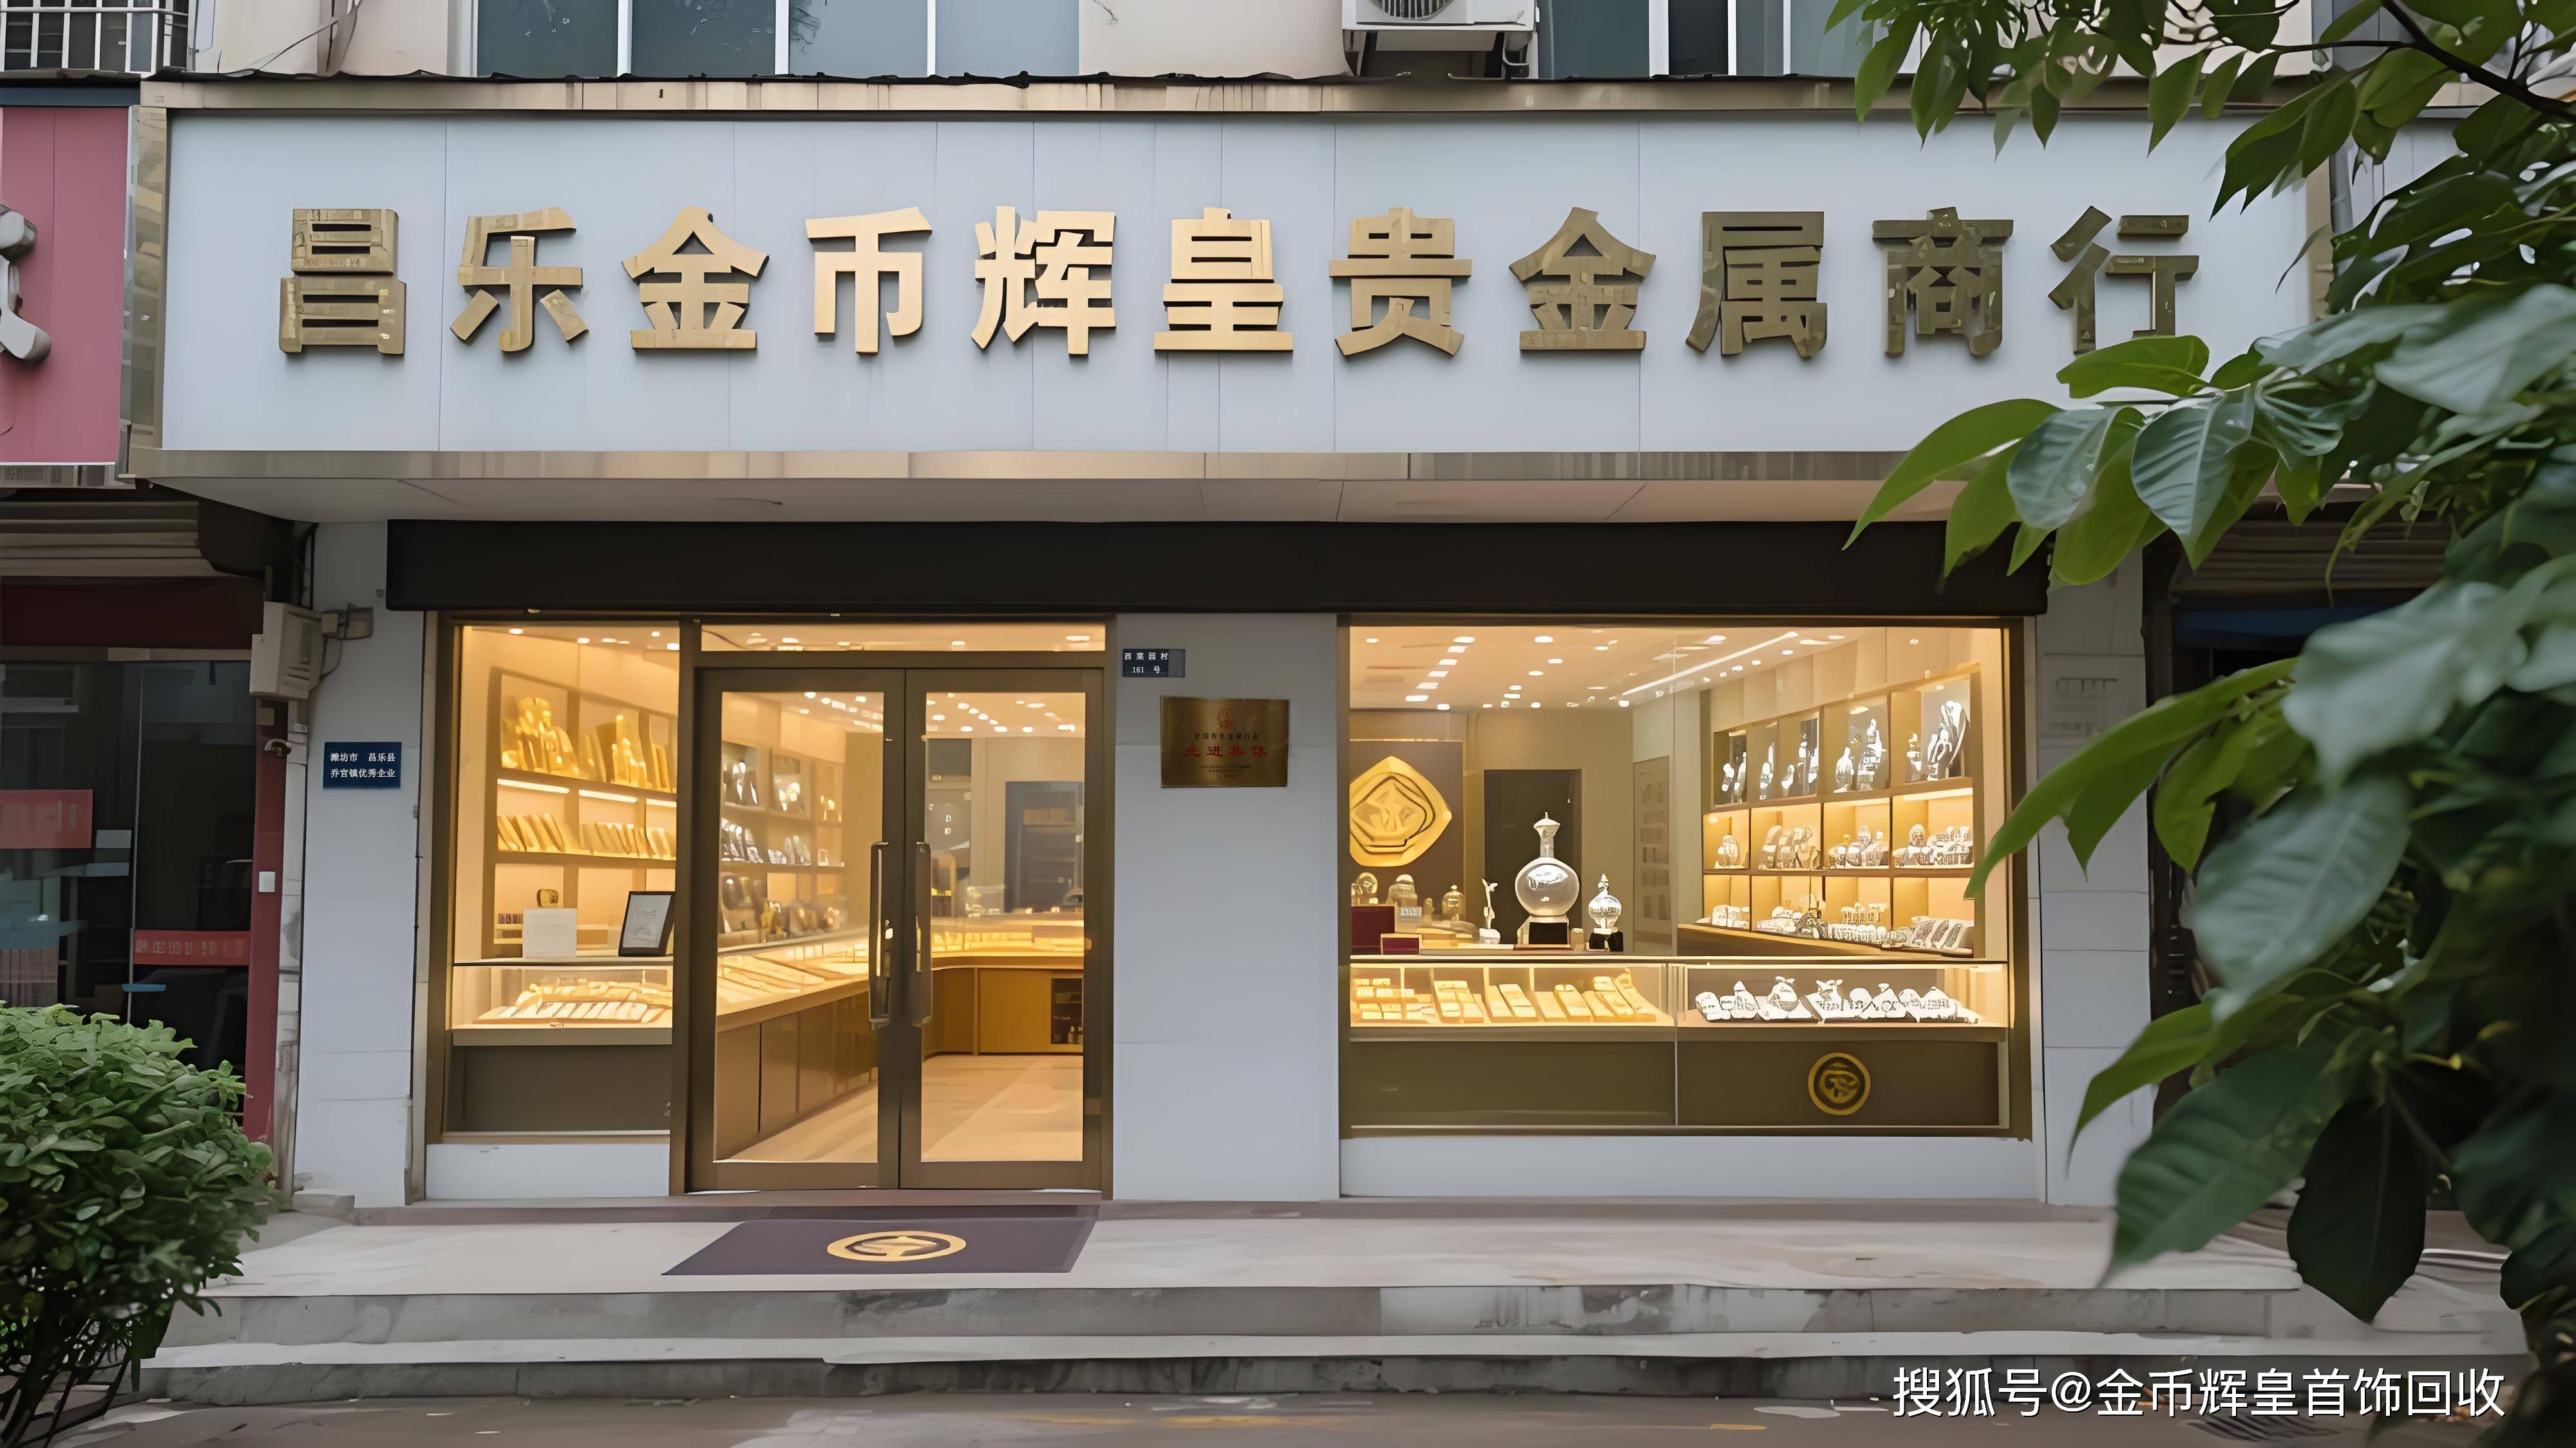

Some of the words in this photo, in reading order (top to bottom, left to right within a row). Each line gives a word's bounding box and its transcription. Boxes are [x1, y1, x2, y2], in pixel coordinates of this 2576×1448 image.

[279, 205, 2200, 357] 昌乐金币辉皇贵金属商行
[1124, 652, 1169, 660] 西菜园村
[1153, 665, 1161, 674] 号
[1184, 744, 1268, 758] 先进集体
[330, 752, 359, 762] 潍坊市
[368, 752, 396, 762] 昌乐县
[330, 768, 396, 777] 乔官镇优秀企业
